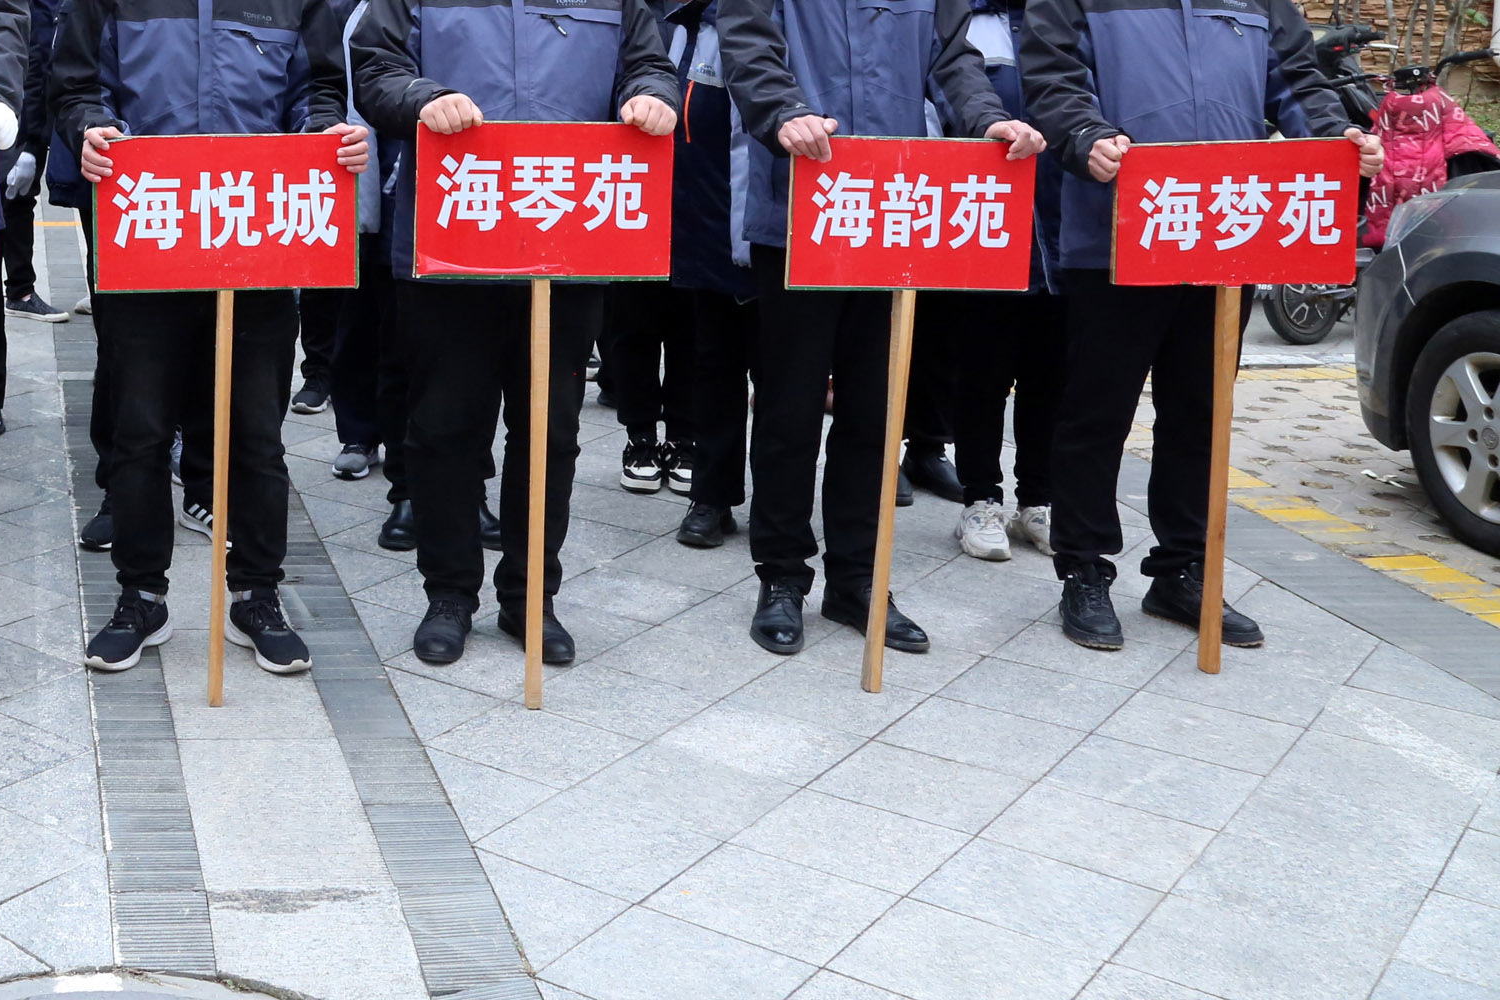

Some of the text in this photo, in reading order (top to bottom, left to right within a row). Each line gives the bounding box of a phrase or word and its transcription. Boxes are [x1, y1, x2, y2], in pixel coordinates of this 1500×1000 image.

[113, 169, 339, 249] 海悦城
[436, 152, 649, 232] 海琴苑
[811, 171, 1012, 249] 海韵苑
[1139, 173, 1342, 251] 海梦苑
